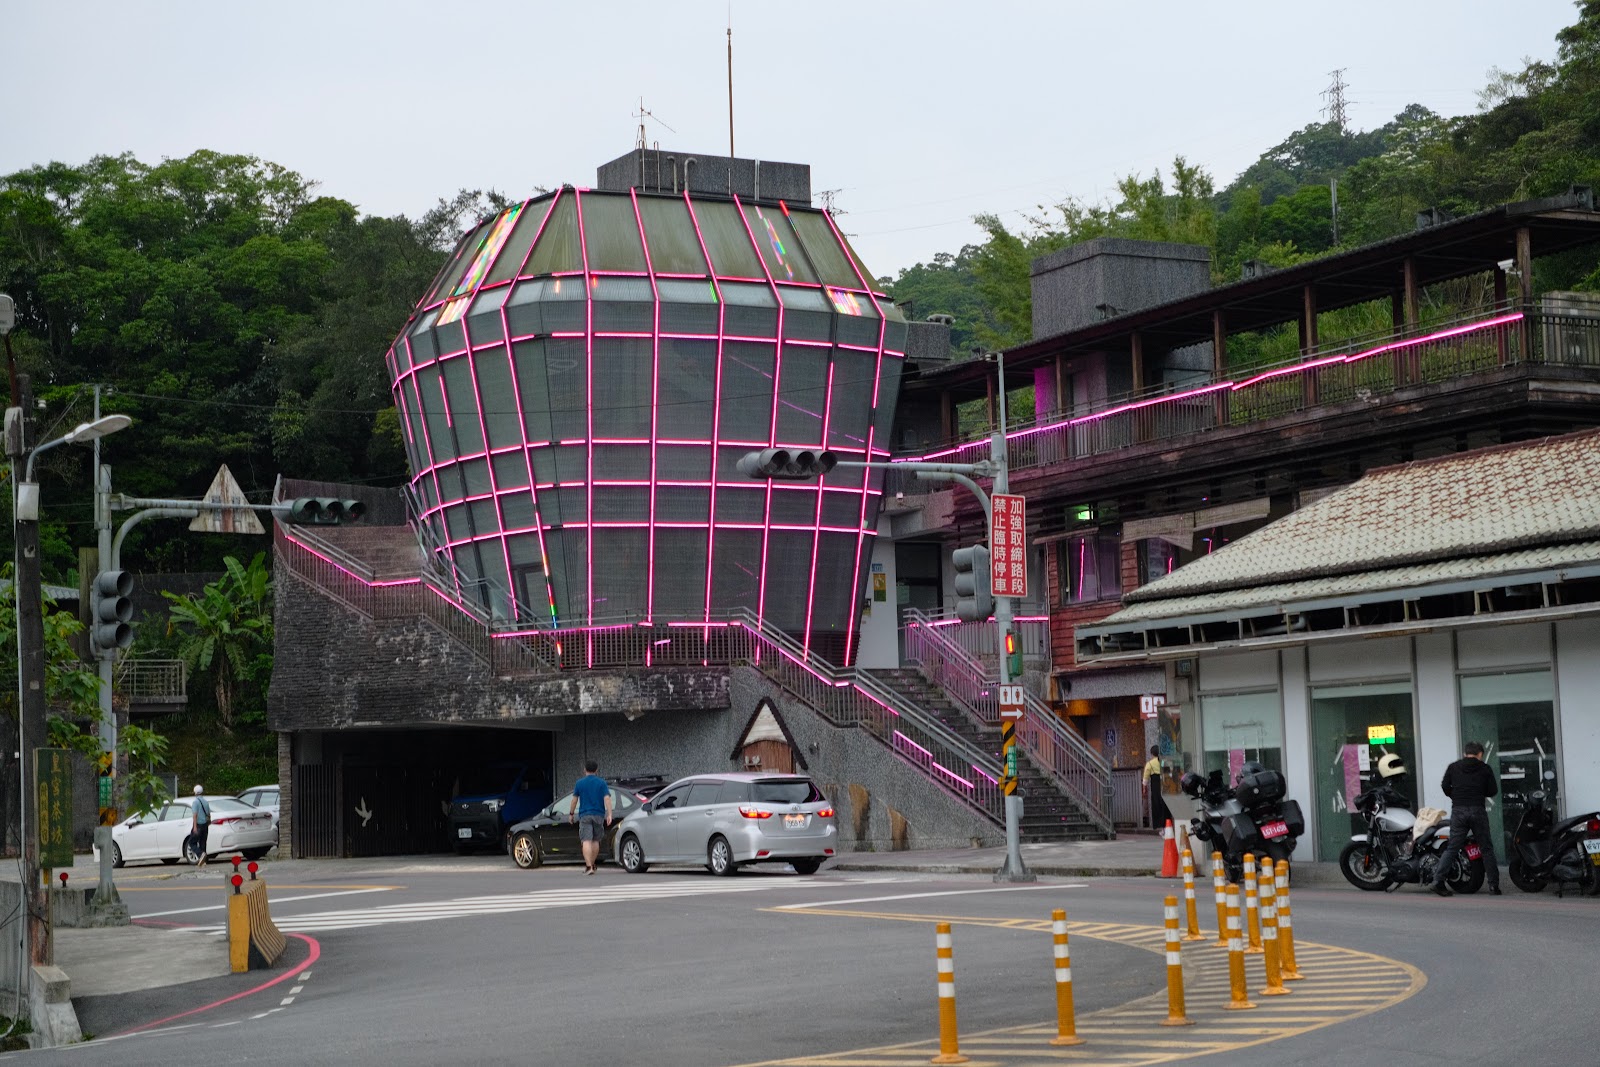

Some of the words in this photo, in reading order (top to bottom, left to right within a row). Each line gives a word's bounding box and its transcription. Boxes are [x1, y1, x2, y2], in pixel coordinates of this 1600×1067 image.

[994, 498, 1007, 593] 禁止臨時停車
[1010, 499, 1024, 594] 加強取締路段
[51, 752, 63, 844] 皇宮茶坊
